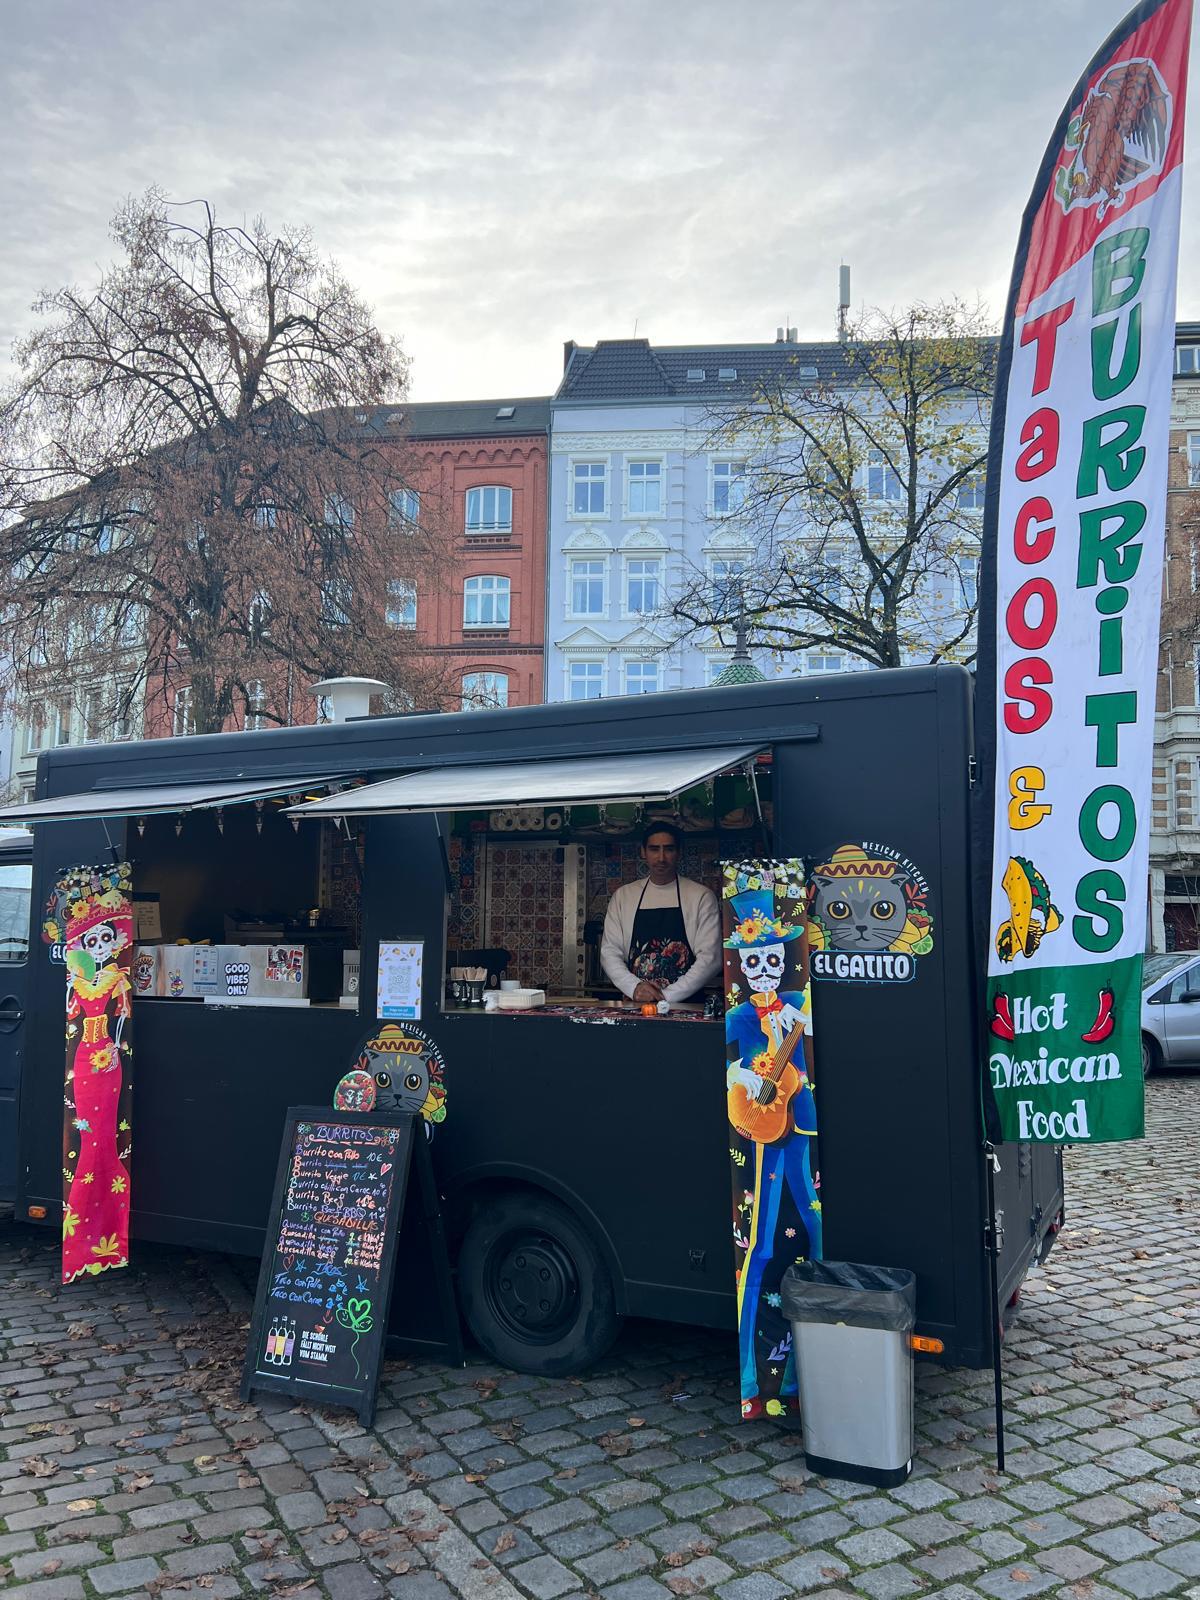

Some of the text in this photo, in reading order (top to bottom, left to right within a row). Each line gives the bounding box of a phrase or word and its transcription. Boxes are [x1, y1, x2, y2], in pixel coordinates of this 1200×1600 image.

[1008, 765, 1052, 831] &
[862, 841, 930, 893] MEXICAN KITCHEN
[52, 945, 62, 959] EL
[224, 963, 249, 974] GOOD
[814, 954, 910, 979] EL GATITO
[225, 974, 249, 985] VIBES
[227, 984, 248, 996] ONLY
[1013, 992, 1069, 1034] Hot
[400, 1022, 446, 1069] MEXICAN KITCHEN
[989, 1046, 1123, 1089] Mexican
[1016, 1099, 1091, 1139] Food
[295, 1144, 327, 1156] Burrito
[292, 1166, 322, 1178] Burrito
[325, 1169, 349, 1185] Veggie
[290, 1177, 319, 1189] Burrito
[288, 1188, 319, 1202] Burrito
[287, 1199, 317, 1211] Burrito
[343, 1207, 367, 1221] BBQ
[271, 1286, 288, 1299] Taco
[301, 1339, 336, 1353] FÄLLT NICHT WEIT
[300, 1350, 310, 1358] VOM
